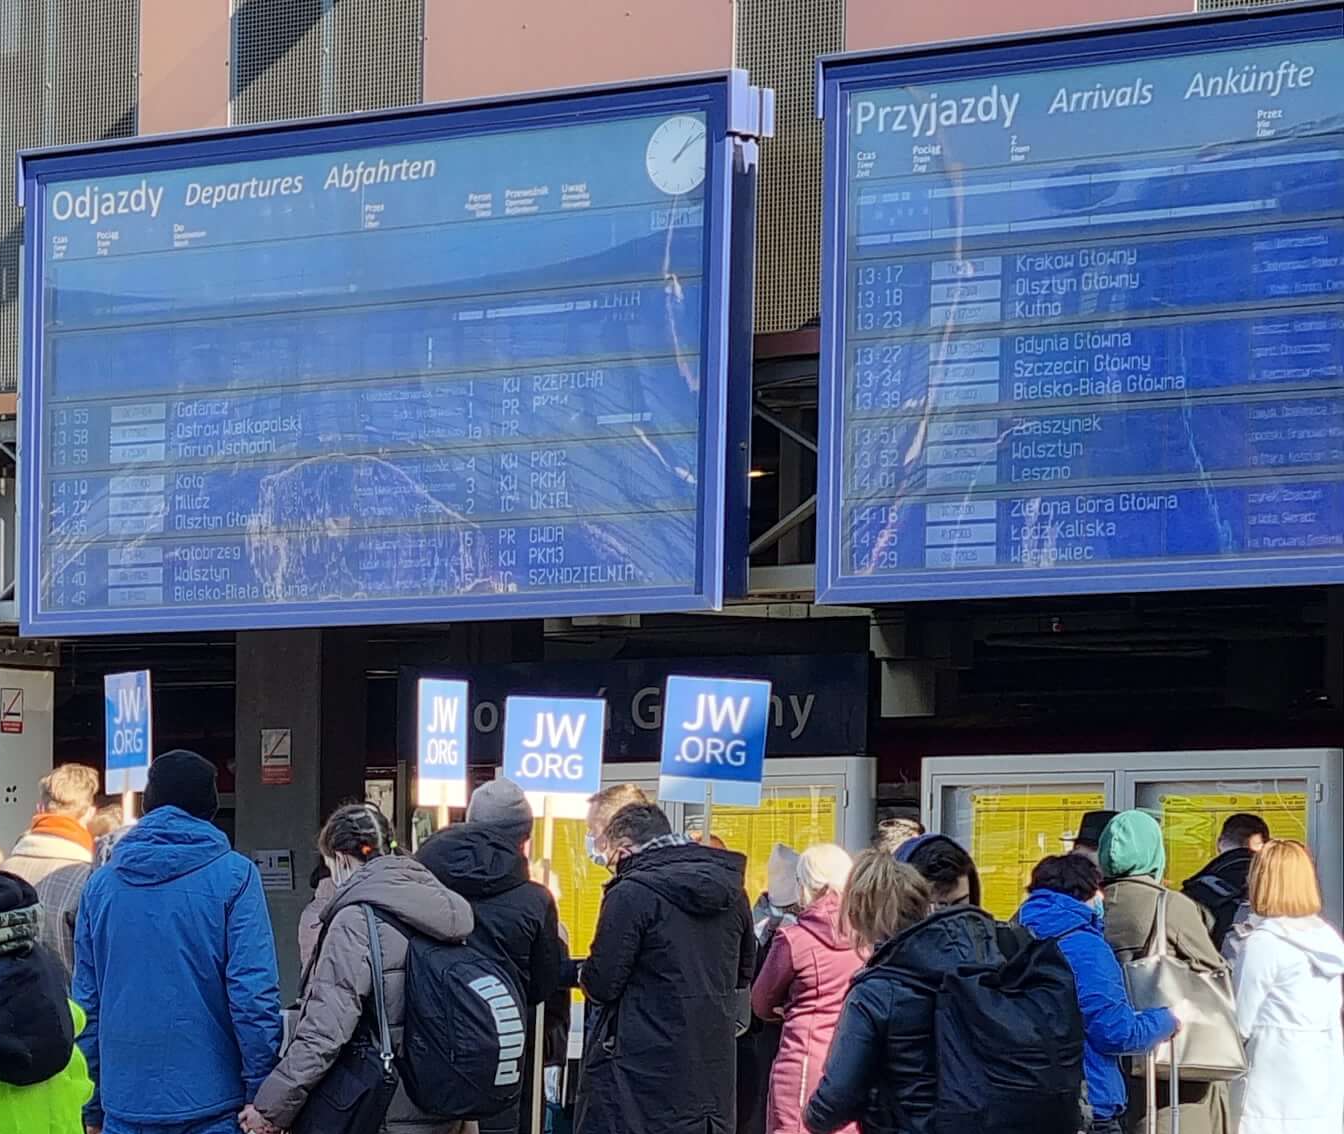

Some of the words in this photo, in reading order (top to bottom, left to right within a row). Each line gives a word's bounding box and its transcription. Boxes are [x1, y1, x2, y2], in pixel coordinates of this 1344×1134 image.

[856, 84, 1019, 137] Przyjazdy
[1048, 77, 1154, 115] Arrivals
[1185, 59, 1315, 100] Ankünfte
[52, 180, 163, 224] Odjazdy
[184, 175, 303, 208] Departures
[324, 159, 436, 192] Abfahrten
[858, 265, 903, 285] 13:17
[857, 289, 903, 308] 13:18
[1016, 278, 1076, 296] Olsztyn
[857, 311, 902, 331] 13:23
[1012, 440, 1083, 459] Wolsztyn
[1012, 464, 1071, 482] Leszno
[114, 687, 141, 724] JW
[427, 696, 458, 733] JW
[682, 693, 750, 734] JW
[112, 728, 143, 755] .ORG
[521, 712, 587, 748] JW
[424, 738, 458, 765] .ORG
[515, 752, 584, 779] .ORG
[675, 736, 746, 766] .ORG
